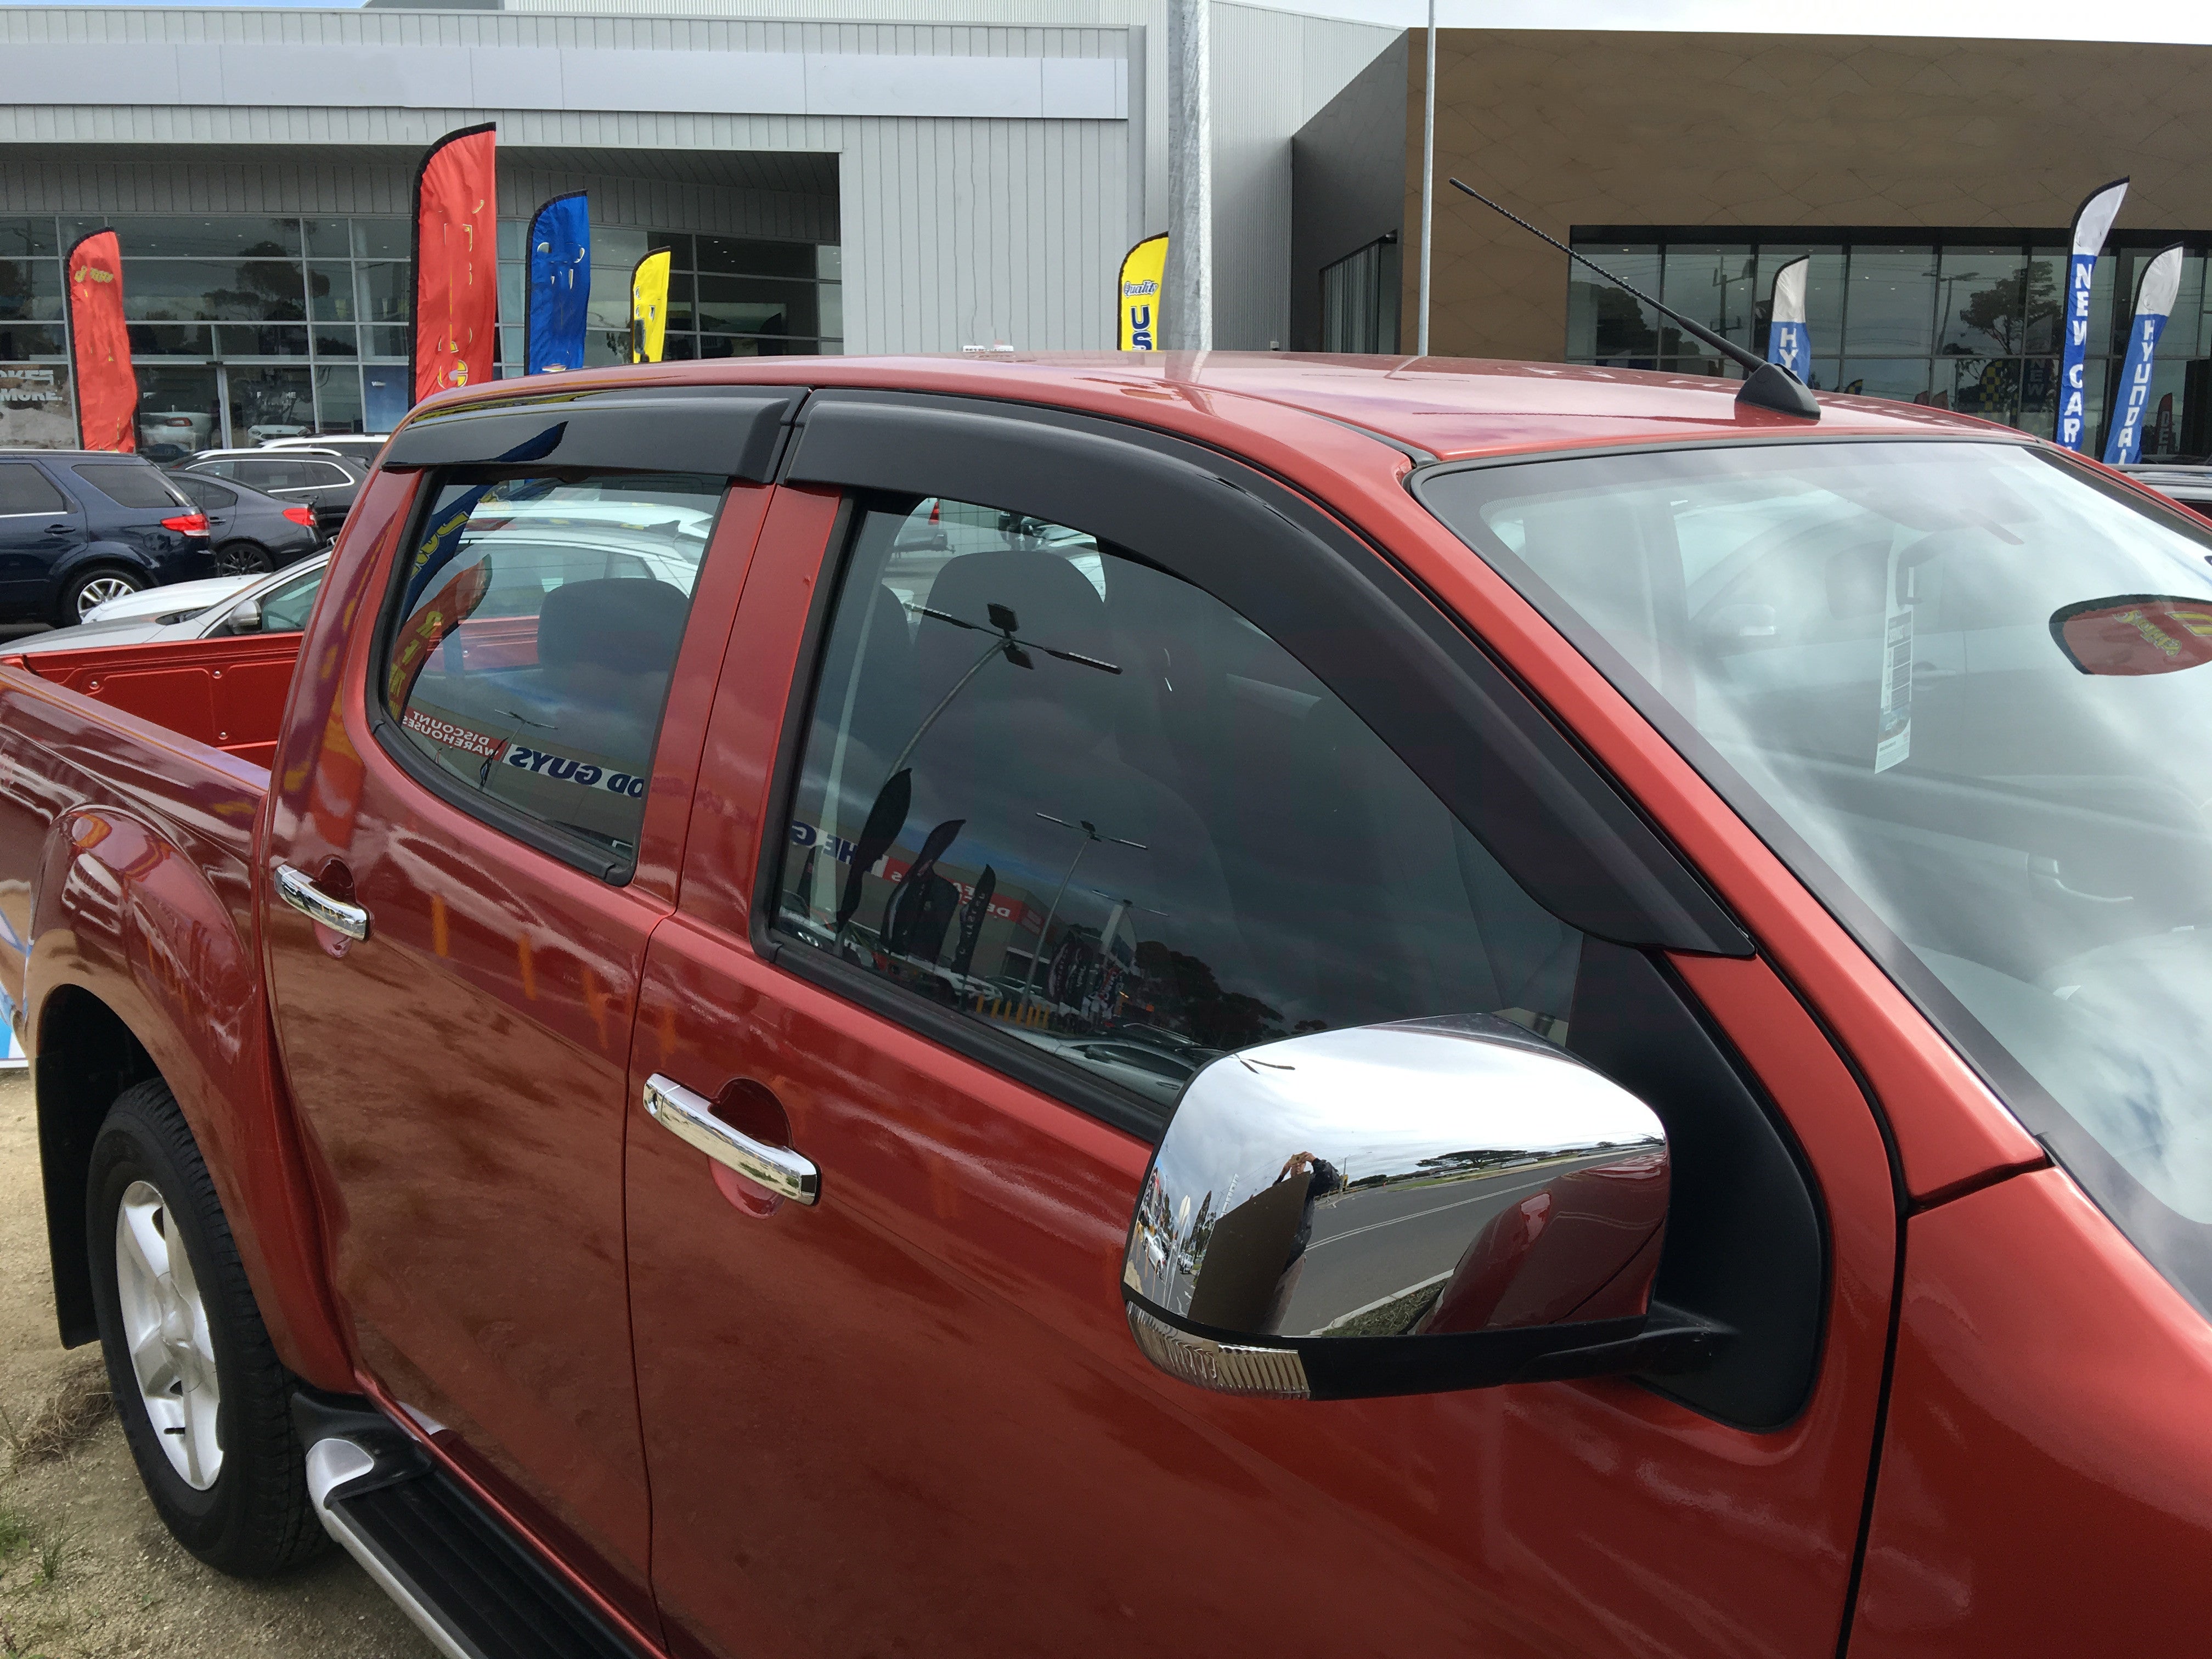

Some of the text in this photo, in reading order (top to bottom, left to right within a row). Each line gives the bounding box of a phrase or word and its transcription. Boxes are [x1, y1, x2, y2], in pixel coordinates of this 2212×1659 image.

[1124, 280, 1158, 297] Quality
[1779, 328, 1799, 376] HY
[2064, 364, 2084, 452] CAR
[2118, 320, 2155, 465] HYUNDAI
